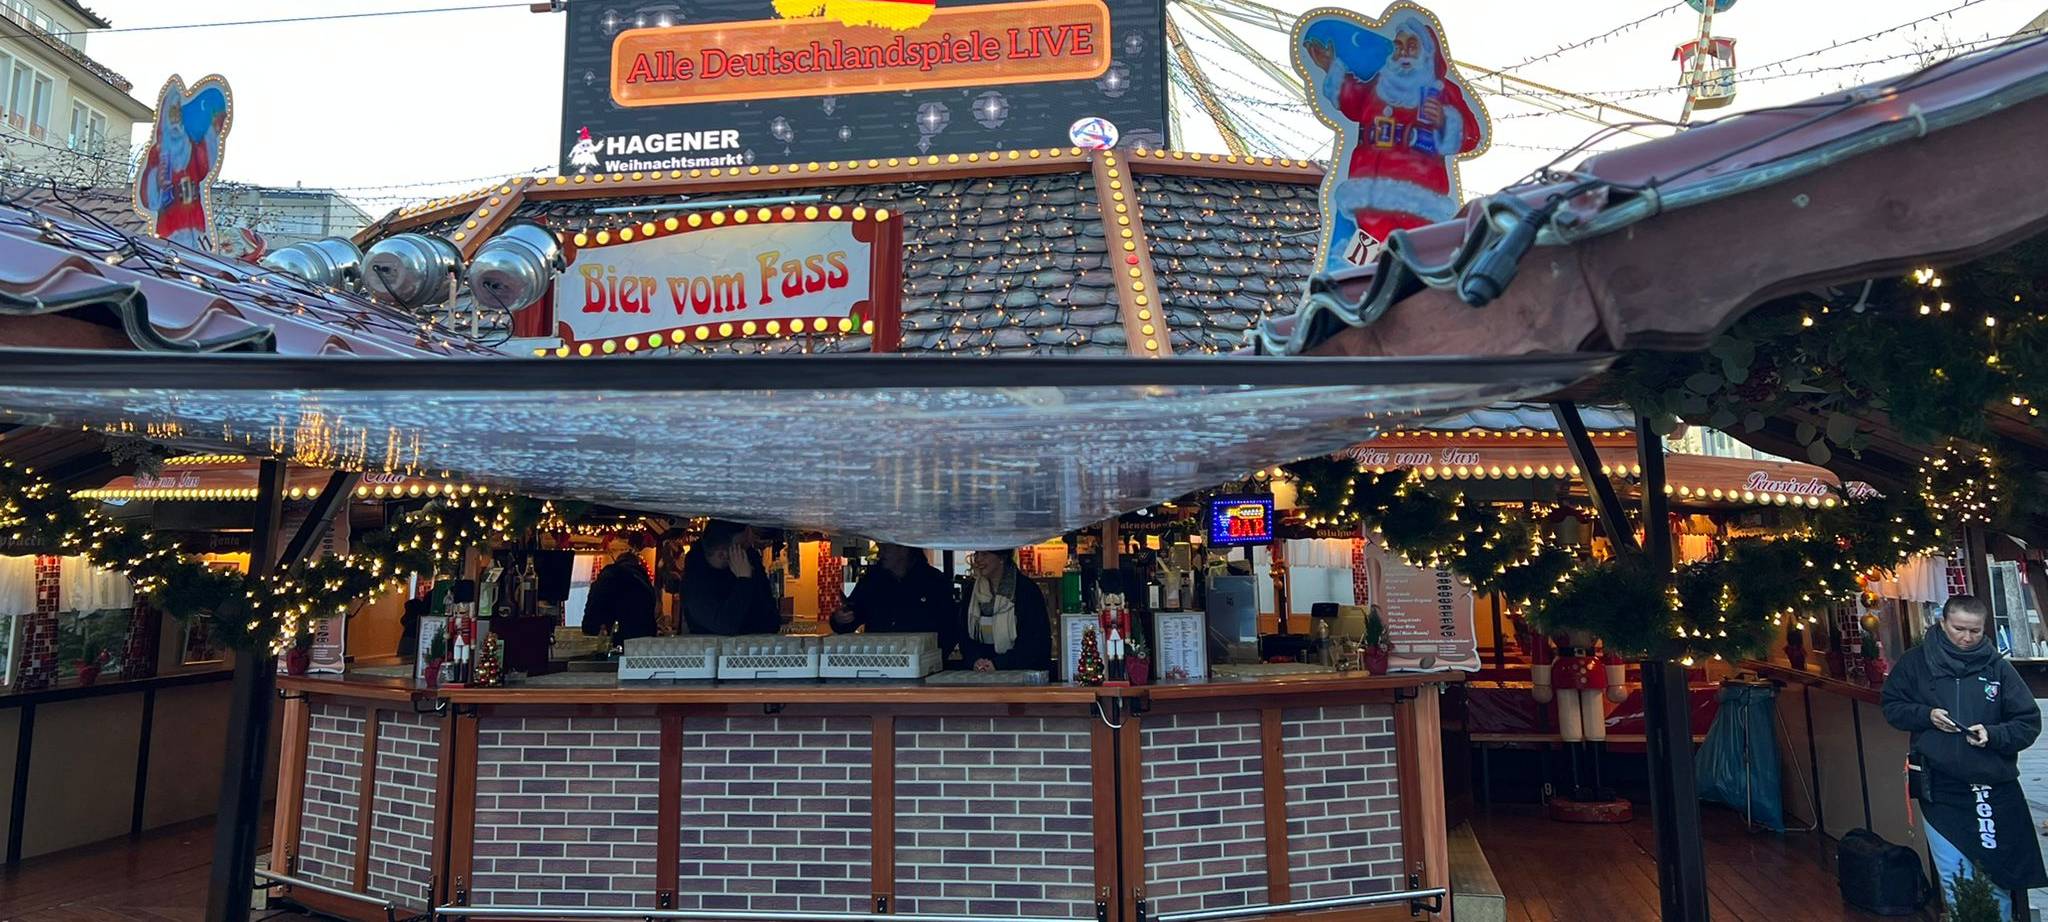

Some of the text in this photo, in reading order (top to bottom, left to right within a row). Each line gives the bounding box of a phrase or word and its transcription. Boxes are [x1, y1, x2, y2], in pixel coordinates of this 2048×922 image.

[627, 23, 1095, 84] Alle Deutschlandspiele LIVE
[605, 129, 740, 156] HAGENER
[605, 152, 744, 173] Weihnachtsmarkt
[578, 249, 850, 316] Bier vom Fass
[1346, 447, 1480, 465] Bier vom Fass
[1742, 470, 1828, 496] Russische
[1229, 516, 1267, 537] BAR
